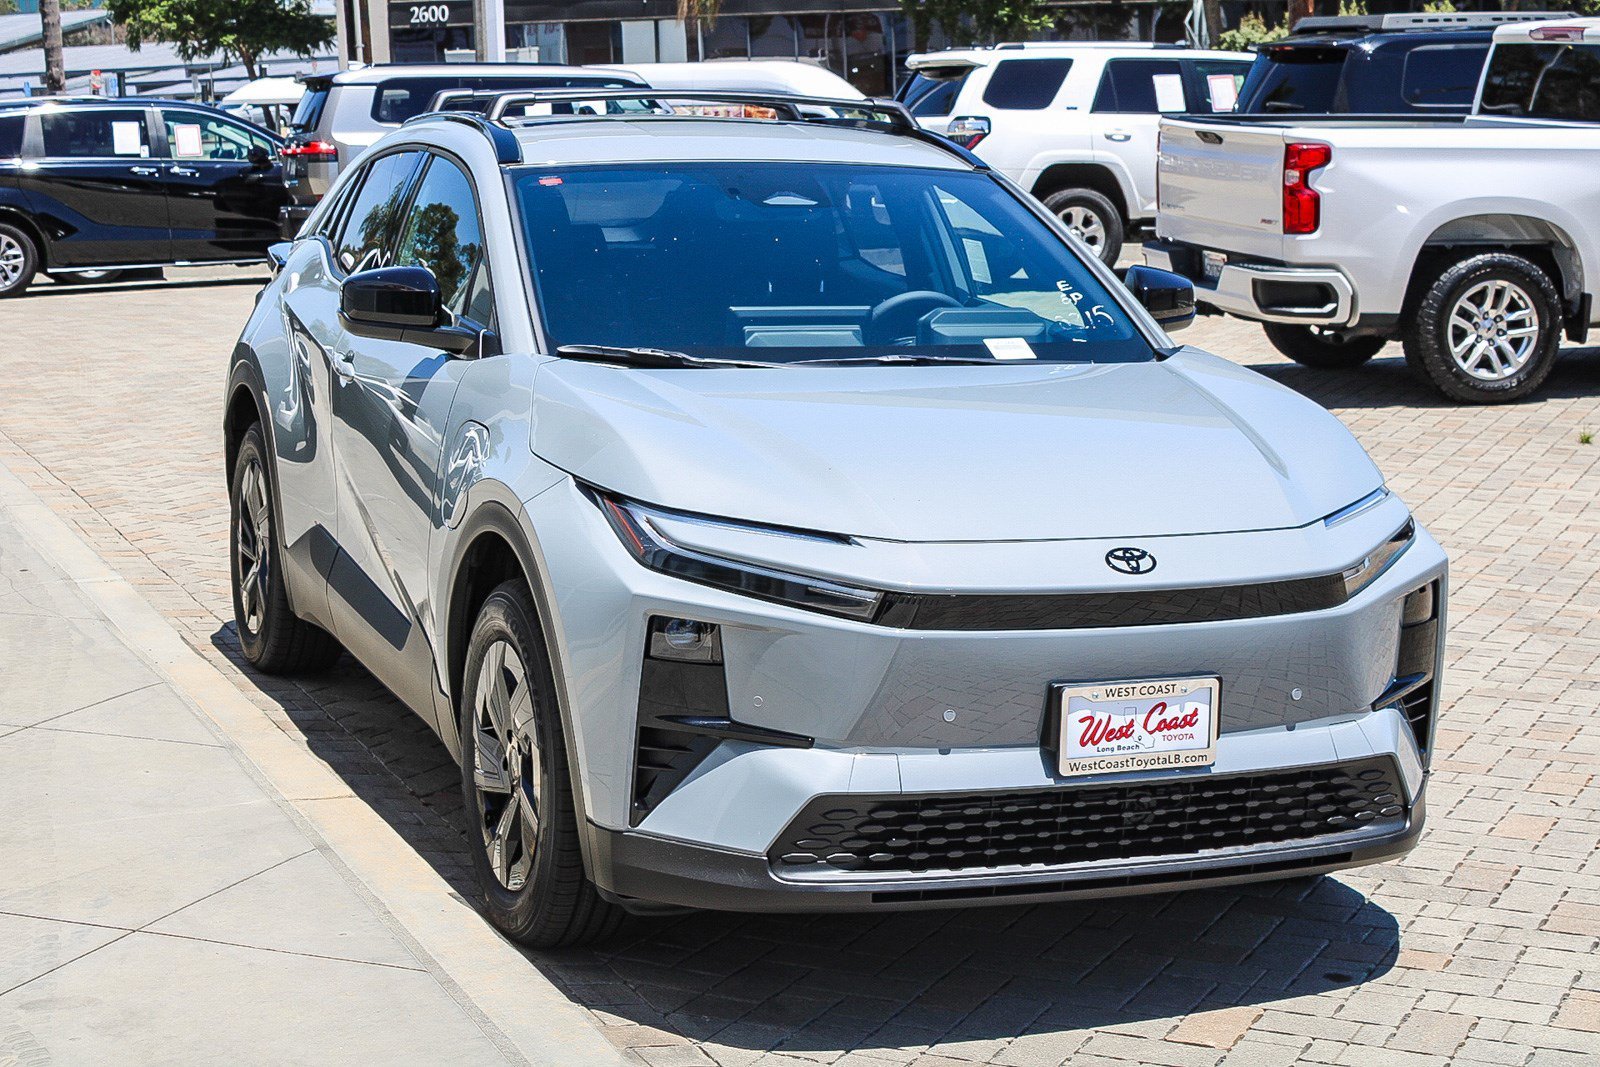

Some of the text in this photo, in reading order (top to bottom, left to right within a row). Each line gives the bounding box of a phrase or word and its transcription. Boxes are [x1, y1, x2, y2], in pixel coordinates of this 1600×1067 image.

[410, 4, 449, 23] 2600
[1105, 684, 1177, 698] WEST COAST
[1078, 701, 1199, 748] West Coast
[1162, 733, 1195, 742] TOYOTA
[1117, 743, 1140, 751] Beach
[1069, 753, 1208, 772] WestCoastToyotaLB.com
